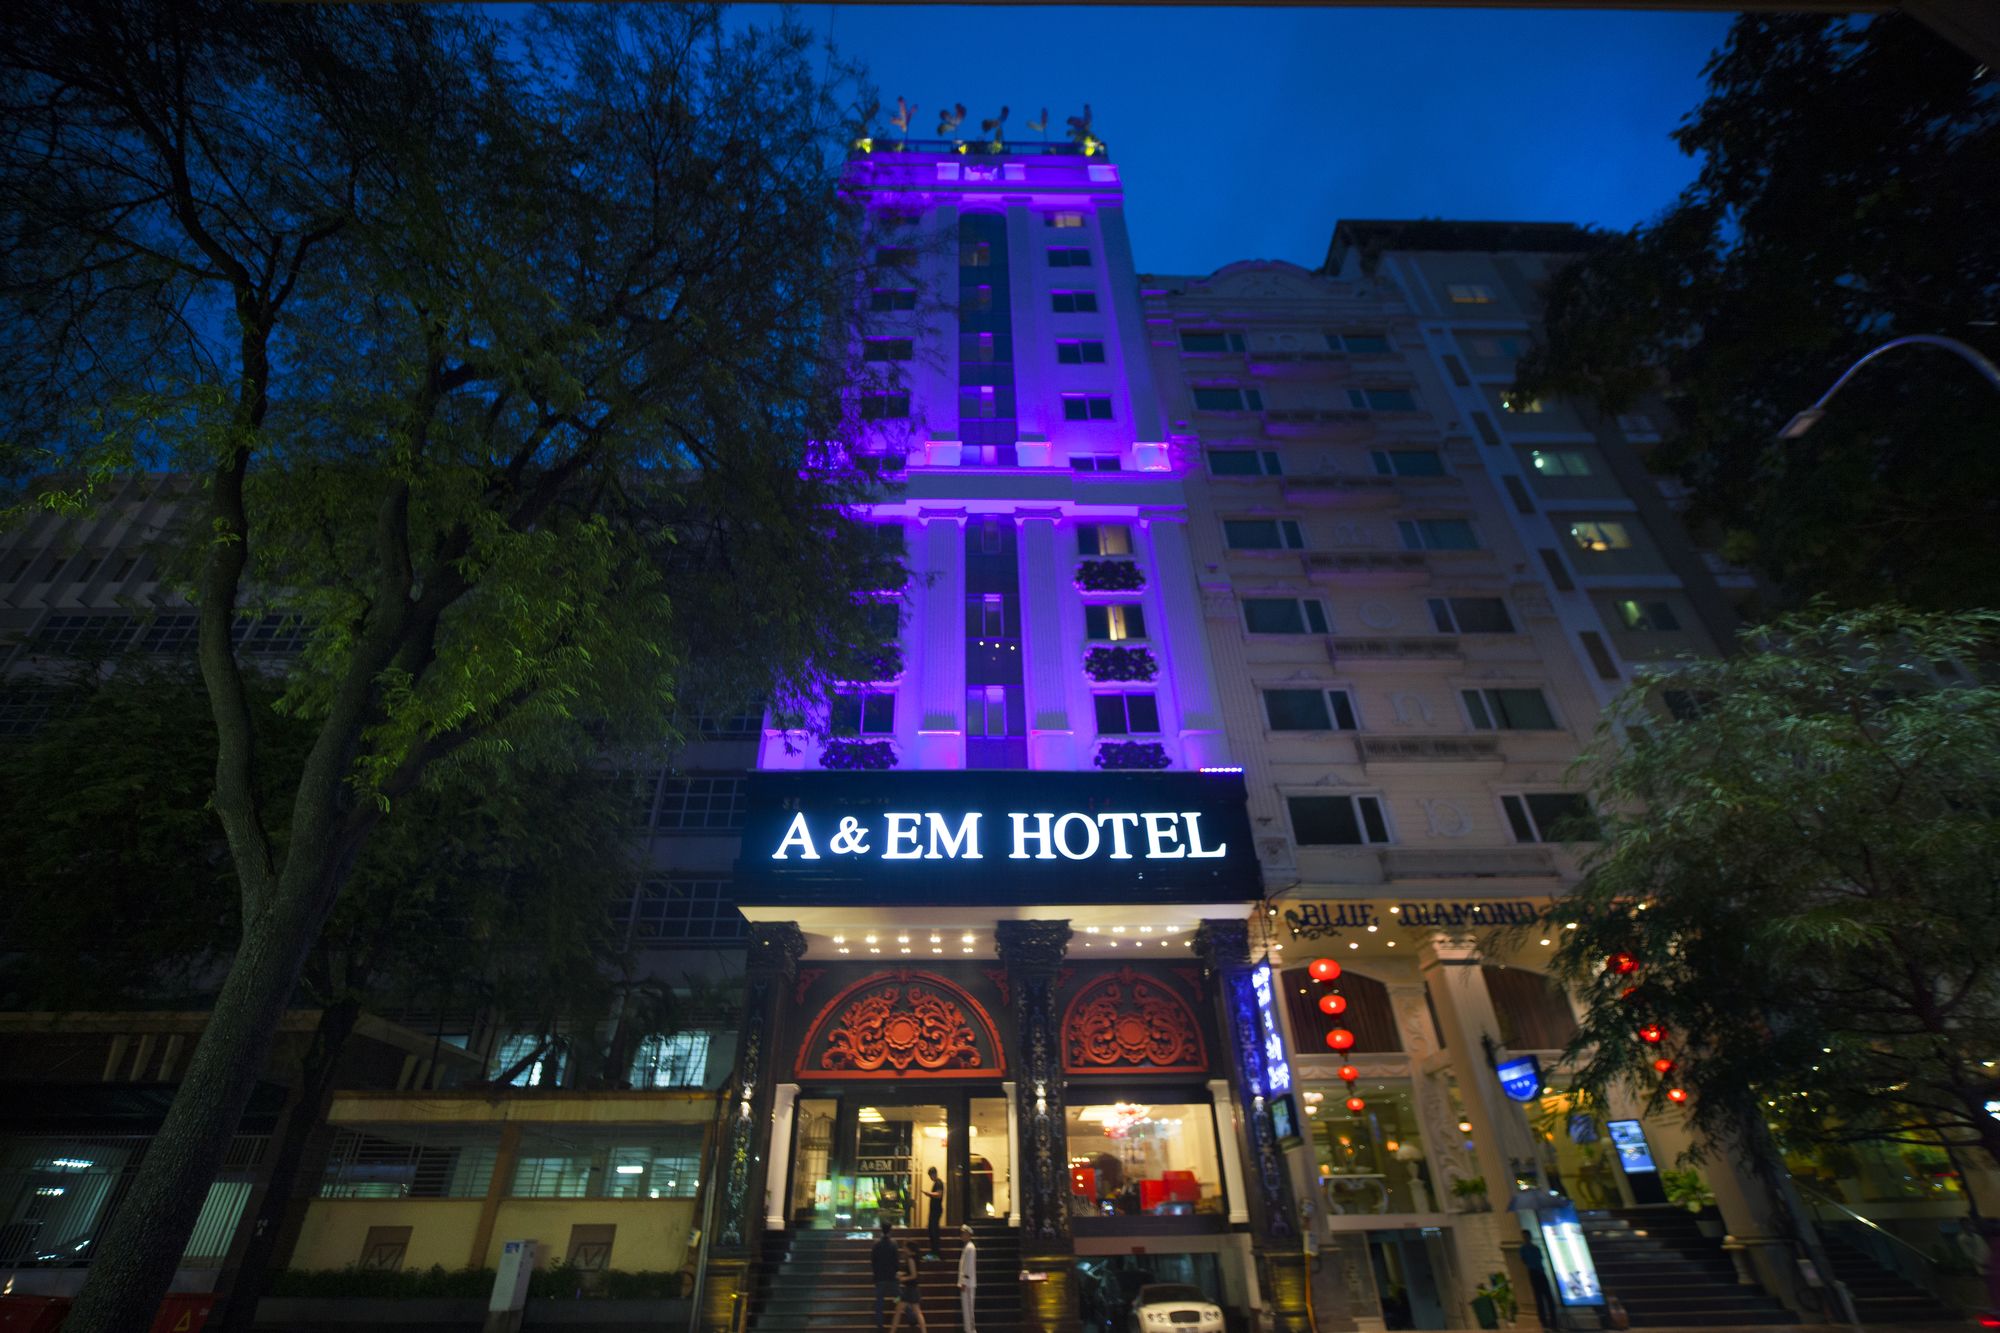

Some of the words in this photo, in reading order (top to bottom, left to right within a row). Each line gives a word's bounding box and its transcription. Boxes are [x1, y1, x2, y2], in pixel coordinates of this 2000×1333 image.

[771, 811, 821, 860] A
[829, 815, 871, 855] &
[880, 812, 984, 860] EM
[1007, 811, 1227, 861] HOTEL
[1298, 903, 1379, 928] BLUE
[1398, 901, 1540, 927] DIAMOND
